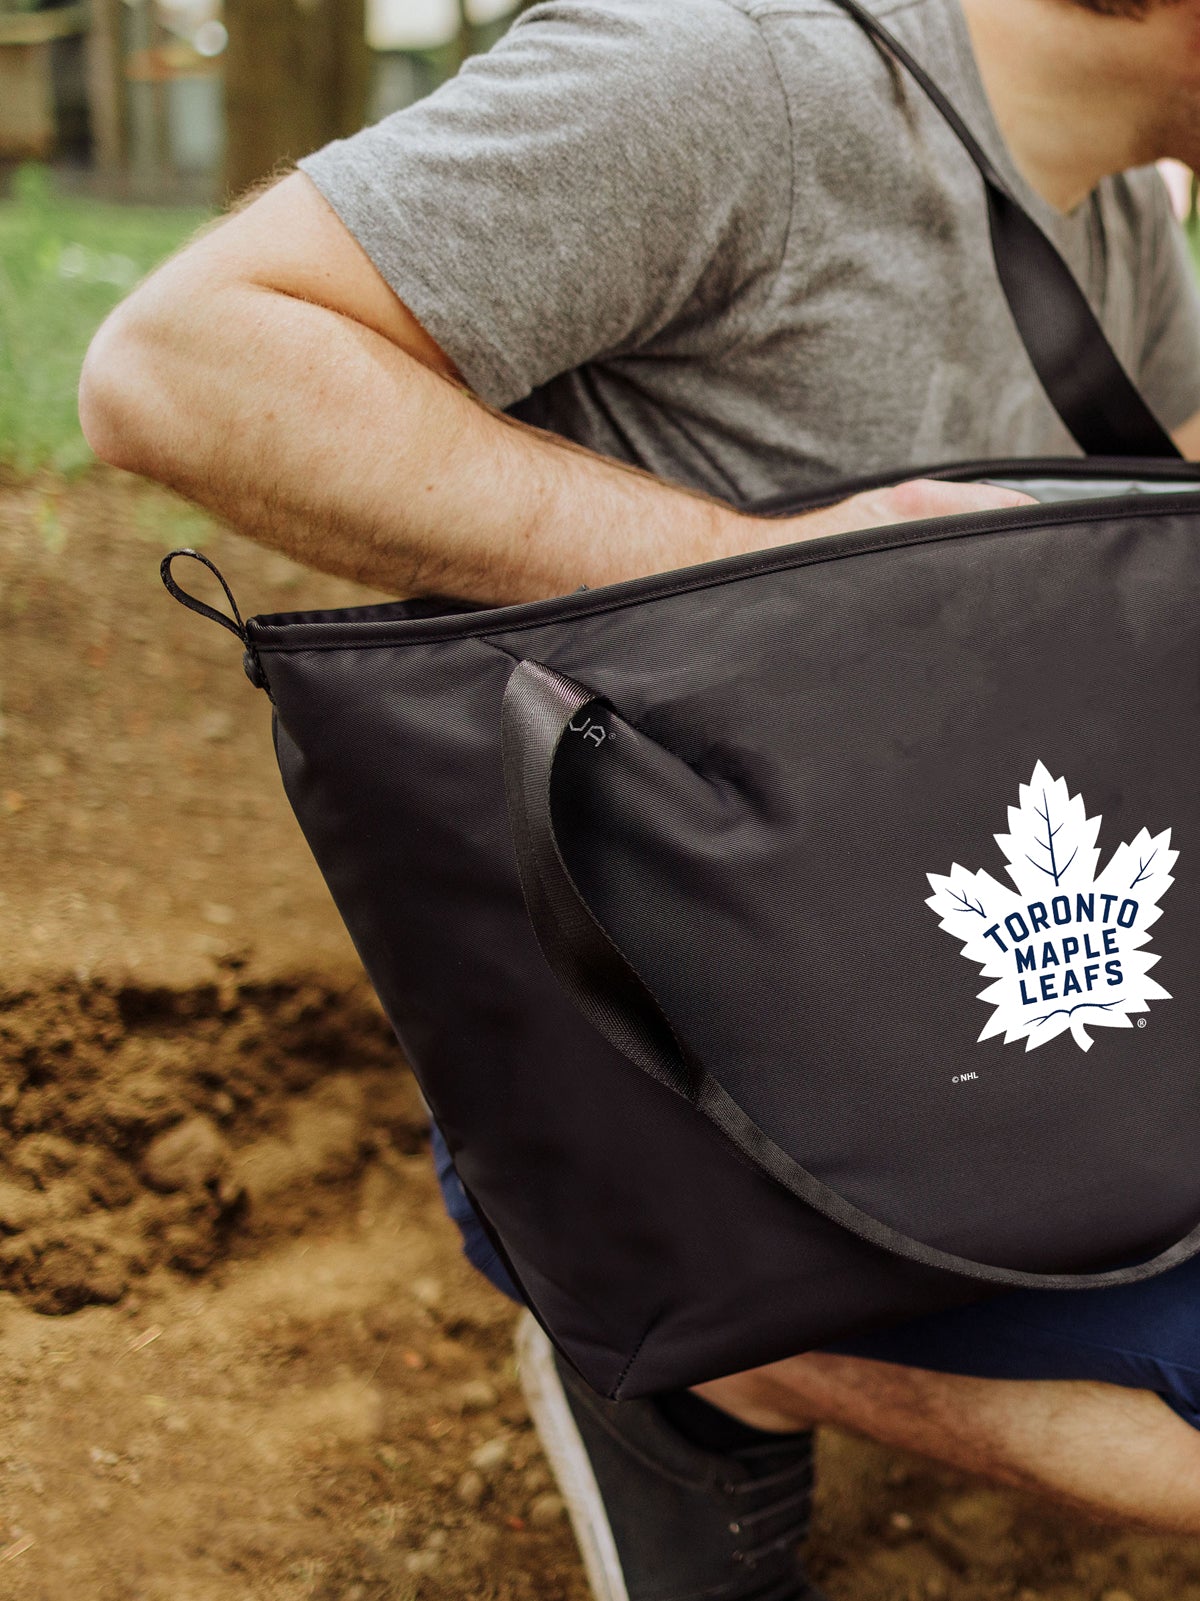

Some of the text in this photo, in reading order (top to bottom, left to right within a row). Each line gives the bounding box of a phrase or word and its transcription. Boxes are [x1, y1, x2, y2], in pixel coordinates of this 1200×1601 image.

[982, 892, 1139, 953] TORONTO
[1014, 927, 1120, 974] MAPLE
[1019, 959, 1124, 1006] LEAFS
[960, 1071, 979, 1082] NHL
